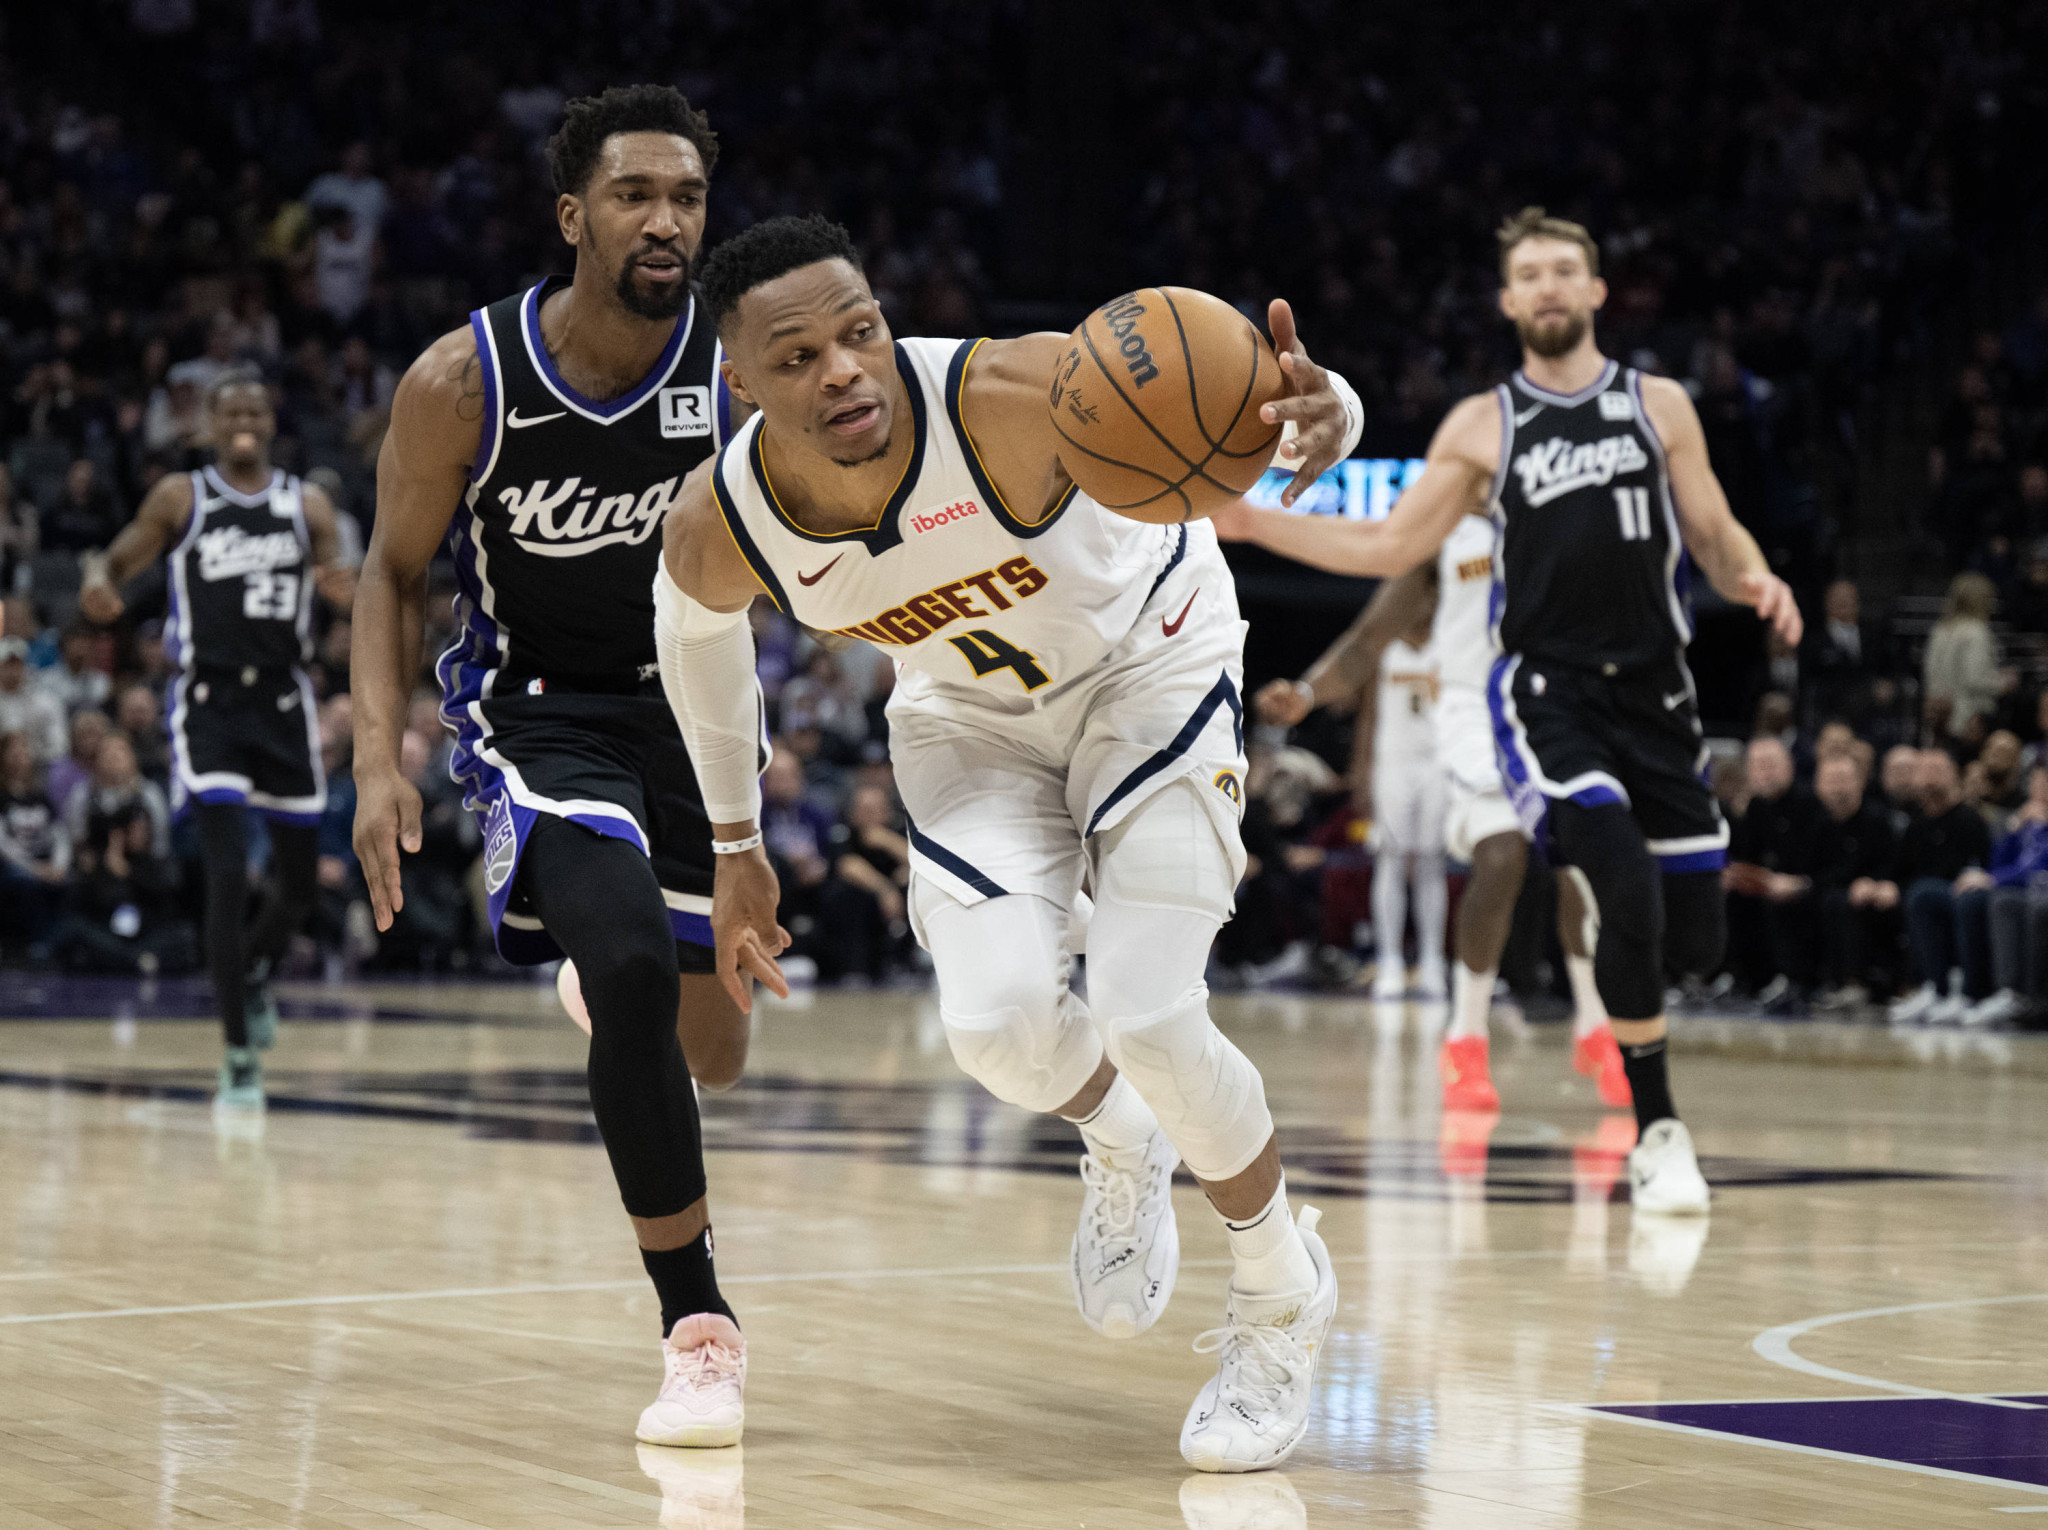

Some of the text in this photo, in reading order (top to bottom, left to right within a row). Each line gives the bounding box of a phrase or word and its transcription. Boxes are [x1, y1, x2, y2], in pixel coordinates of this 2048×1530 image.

[664, 423, 708, 431] REVIVER
[671, 393, 701, 418] R
[1513, 434, 1648, 508] Kings
[498, 476, 686, 557] King
[910, 501, 979, 534] ibotta
[1613, 486, 1651, 540] 11
[243, 572, 298, 620] 23
[828, 554, 1049, 646] UGGETS
[944, 629, 1053, 694] 4
